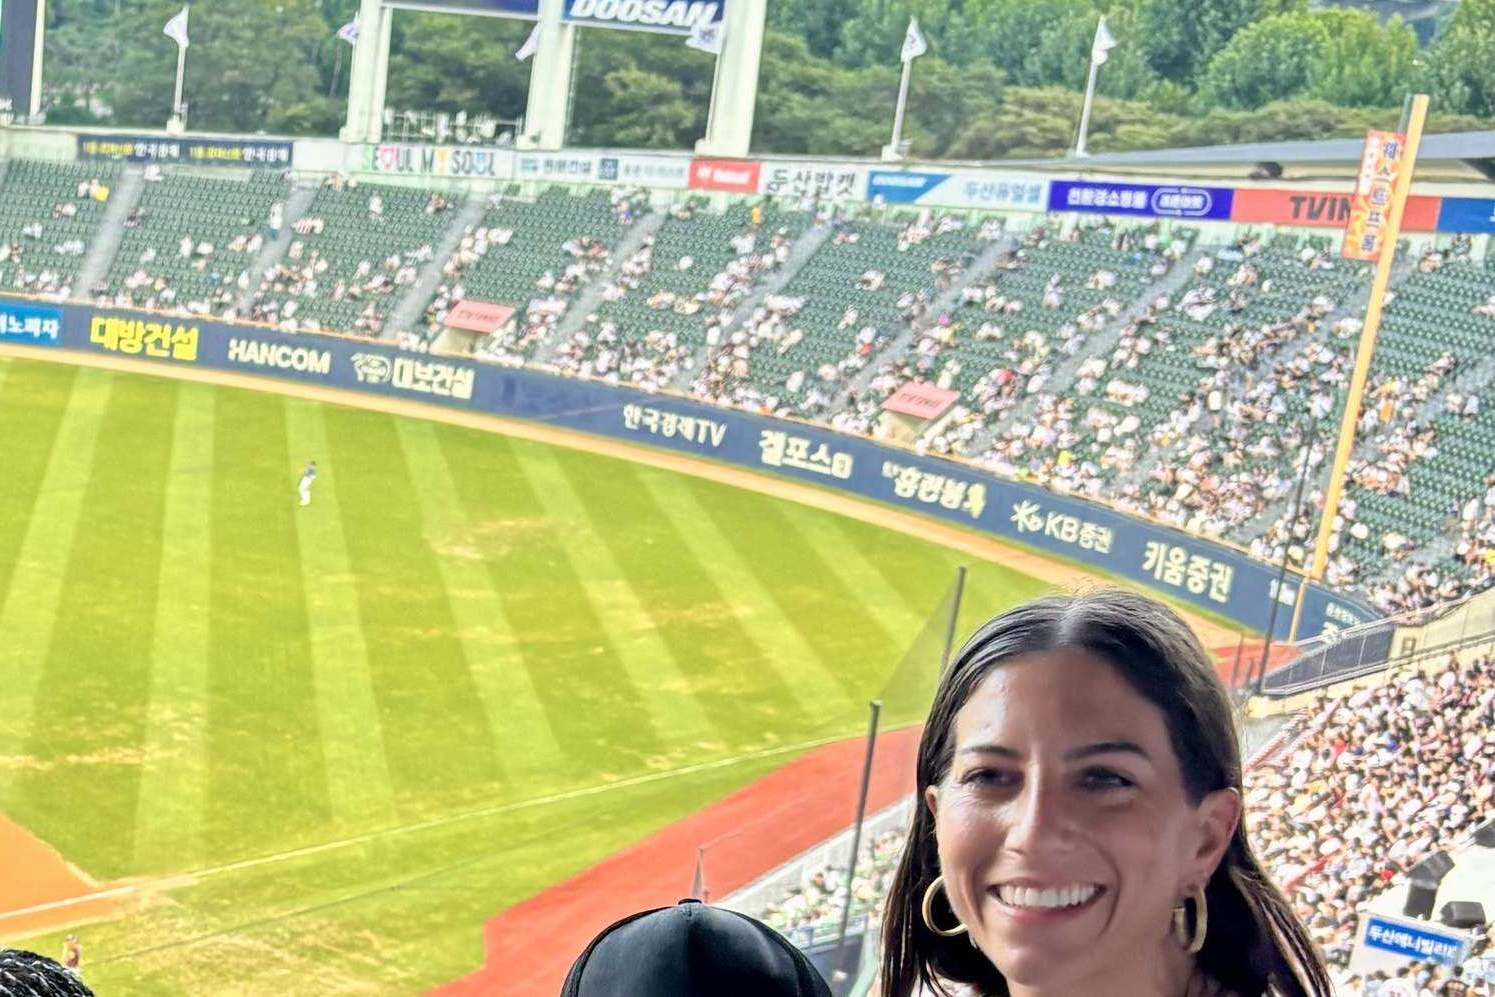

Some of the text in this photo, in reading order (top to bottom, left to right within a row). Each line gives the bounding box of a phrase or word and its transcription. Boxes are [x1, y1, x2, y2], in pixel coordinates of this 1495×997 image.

[570, 0, 718, 27] DOOSAN
[1290, 195, 1353, 220] TVIN
[90, 316, 199, 361] 대방건설
[228, 338, 332, 375] HANCOM
[392, 357, 476, 400] 대보건설
[623, 403, 728, 448] 한국경제TV
[1142, 540, 1235, 604] 키움증권
